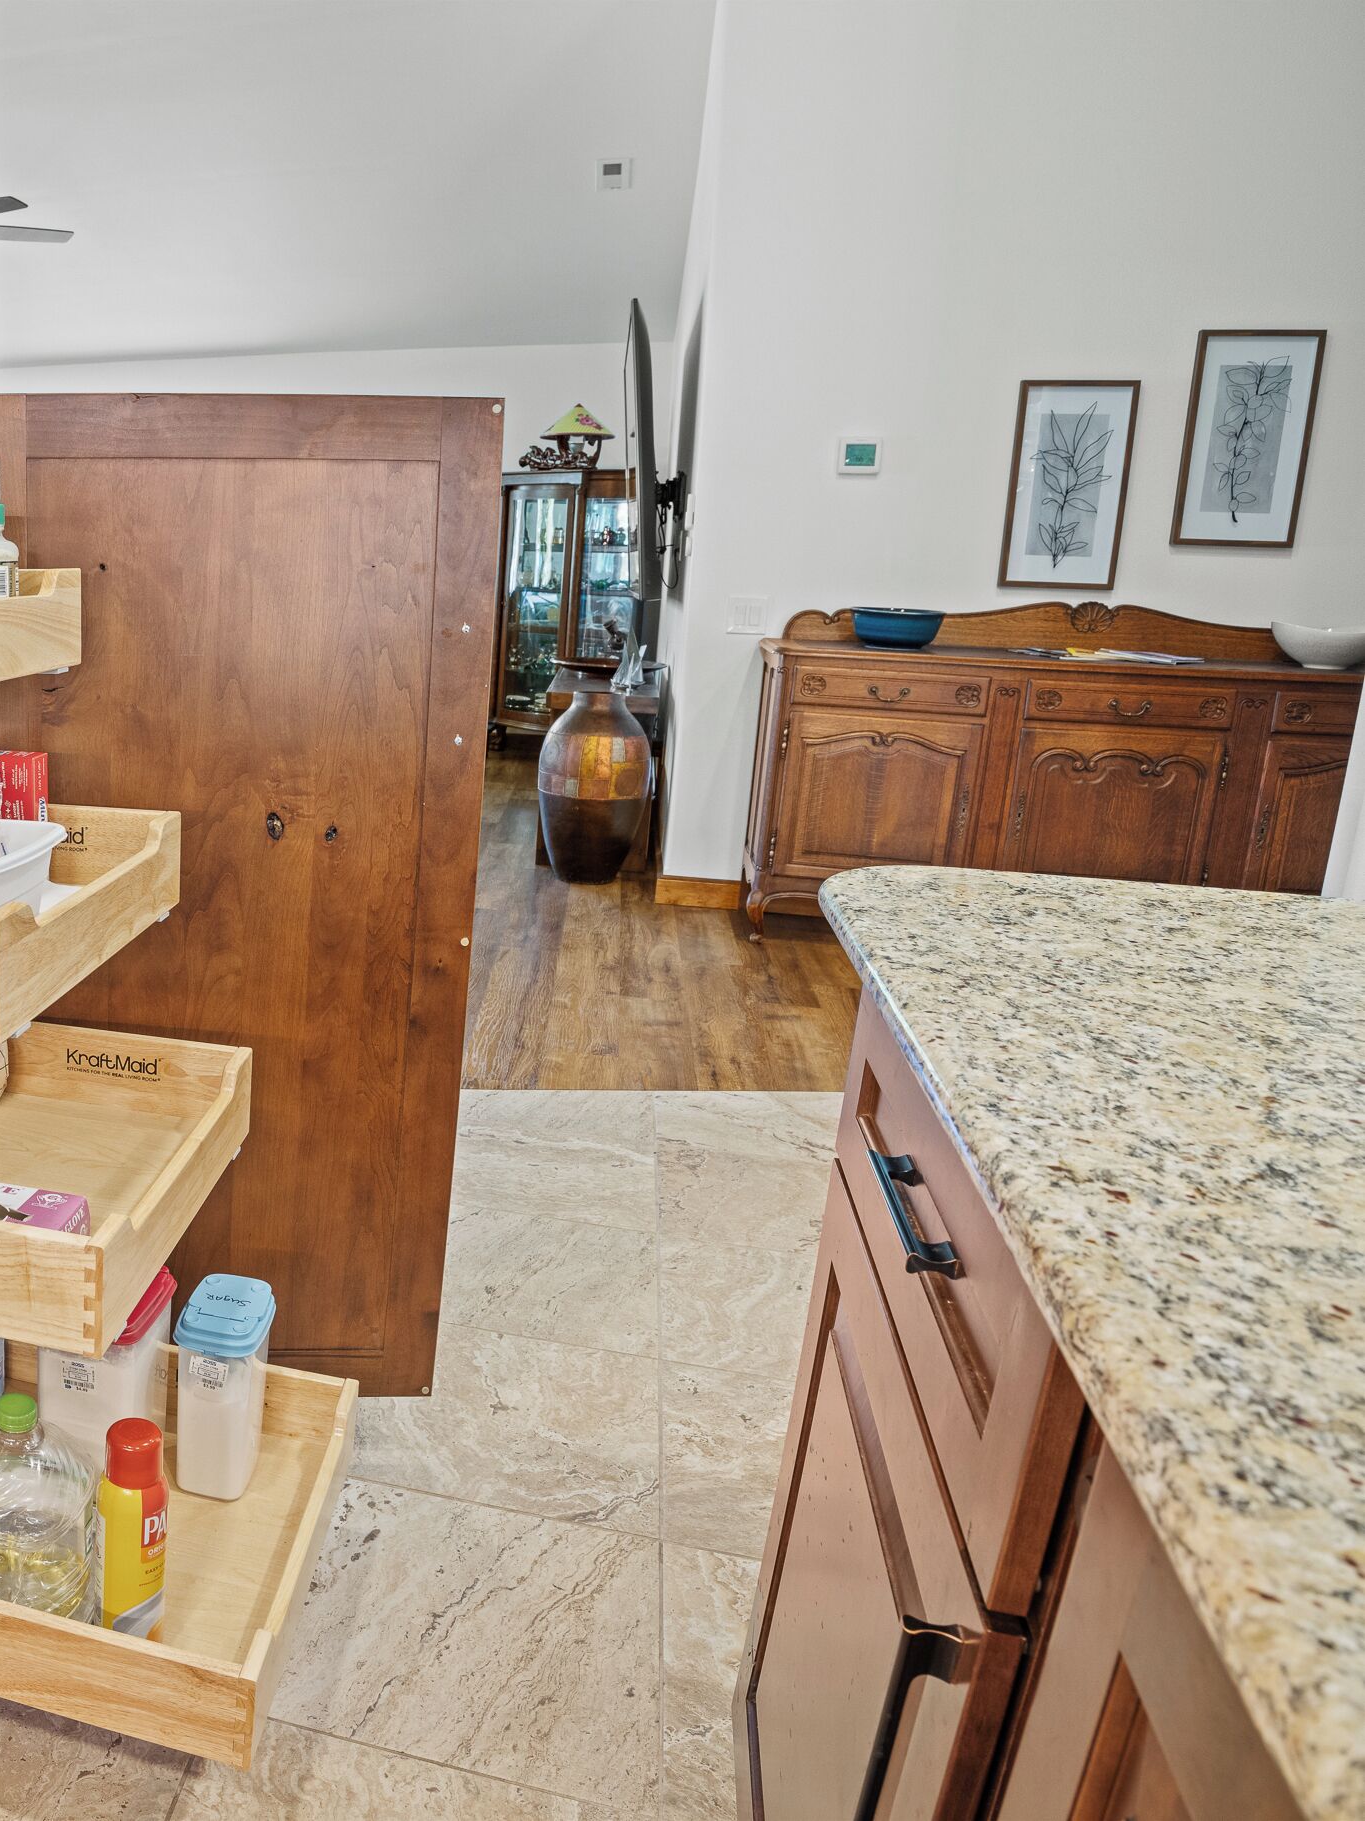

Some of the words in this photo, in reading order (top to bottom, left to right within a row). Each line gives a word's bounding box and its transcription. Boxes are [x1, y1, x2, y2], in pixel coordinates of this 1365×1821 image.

[66, 1048, 157, 1075] KraftMaid
[66, 1066, 90, 1074] KITCHENS
[144, 1510, 168, 1545] PA
